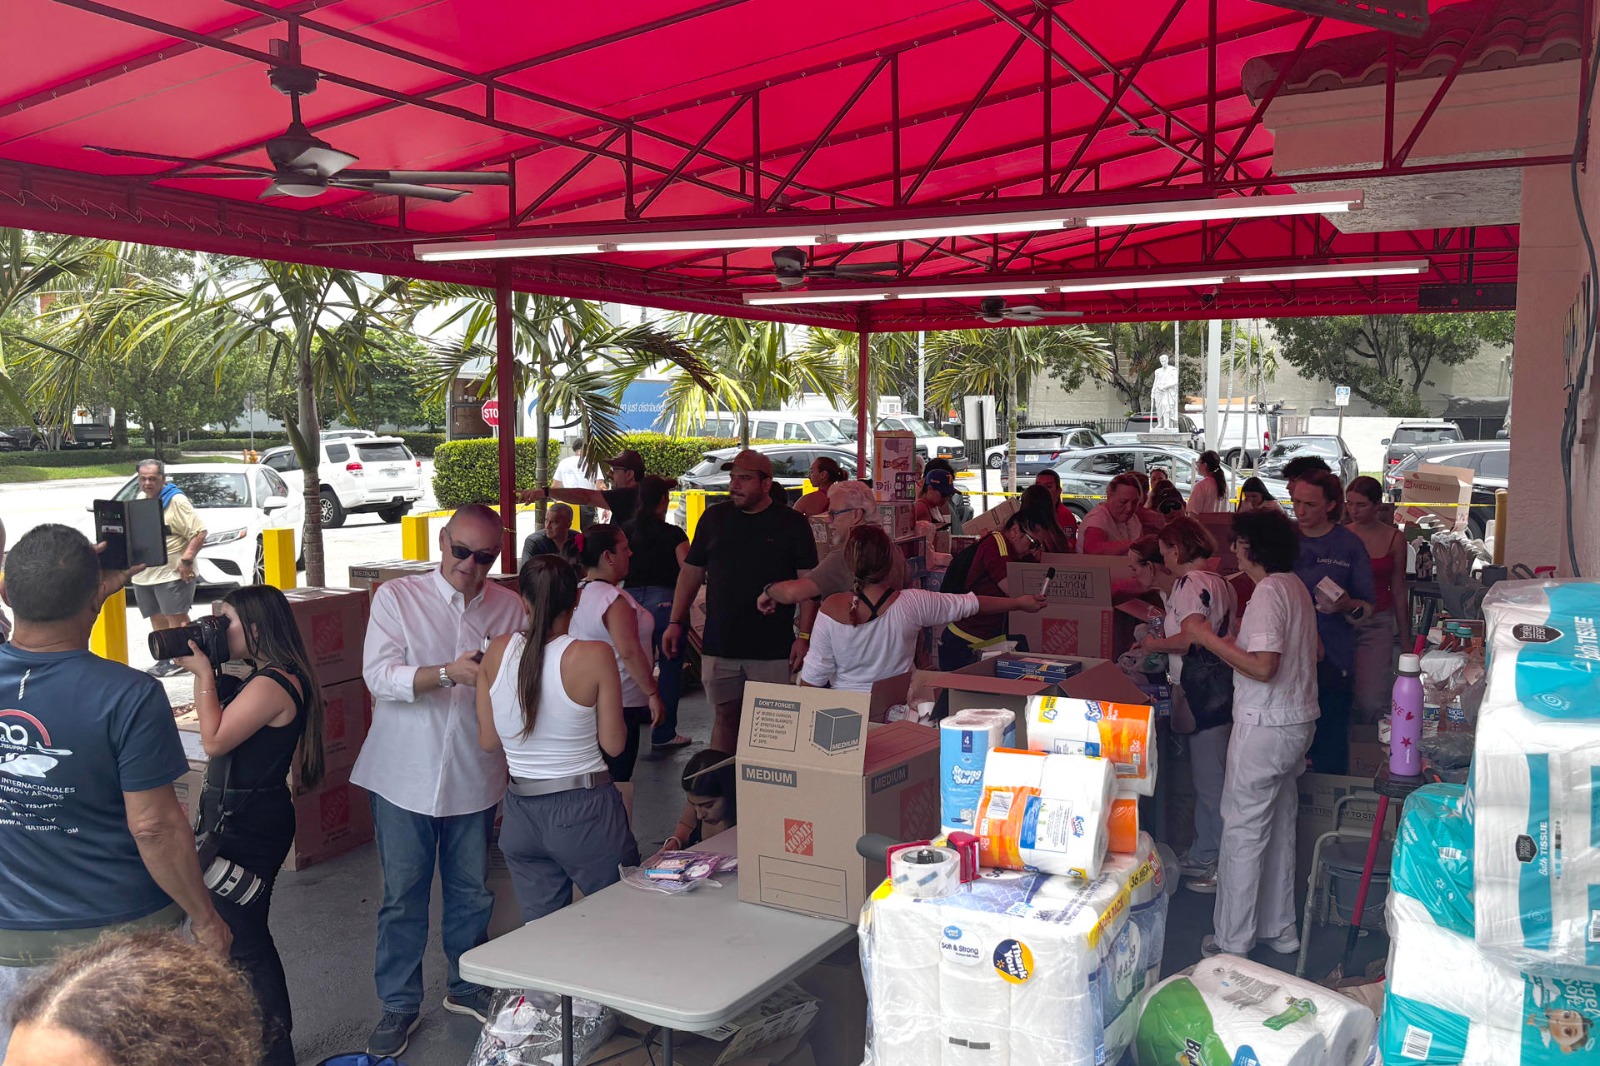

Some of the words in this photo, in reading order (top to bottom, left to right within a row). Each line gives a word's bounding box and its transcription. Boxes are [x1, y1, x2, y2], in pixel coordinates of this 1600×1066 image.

[484, 409, 499, 418] STO
[1413, 483, 1441, 492] MEDIUM
[832, 739, 859, 750] MEDIUM
[964, 736, 970, 745] 4
[746, 767, 793, 785] MEDIUM
[874, 768, 907, 790] MEDIUM
[952, 765, 982, 780] Strong
[1, 777, 76, 793] INTERNACIONALES
[785, 821, 813, 853] HOME
[788, 823, 800, 837] THE
[1540, 821, 1548, 856] TISSUE
[796, 836, 814, 854] DEPOT
[1538, 857, 1548, 876] Bath
[1129, 874, 1139, 888] 36
[941, 941, 952, 950] Soft
[958, 945, 979, 955] Strong
[1003, 949, 1018, 977] You!
[1011, 942, 1028, 980] Thank
[1580, 980, 1600, 1018] ngel
